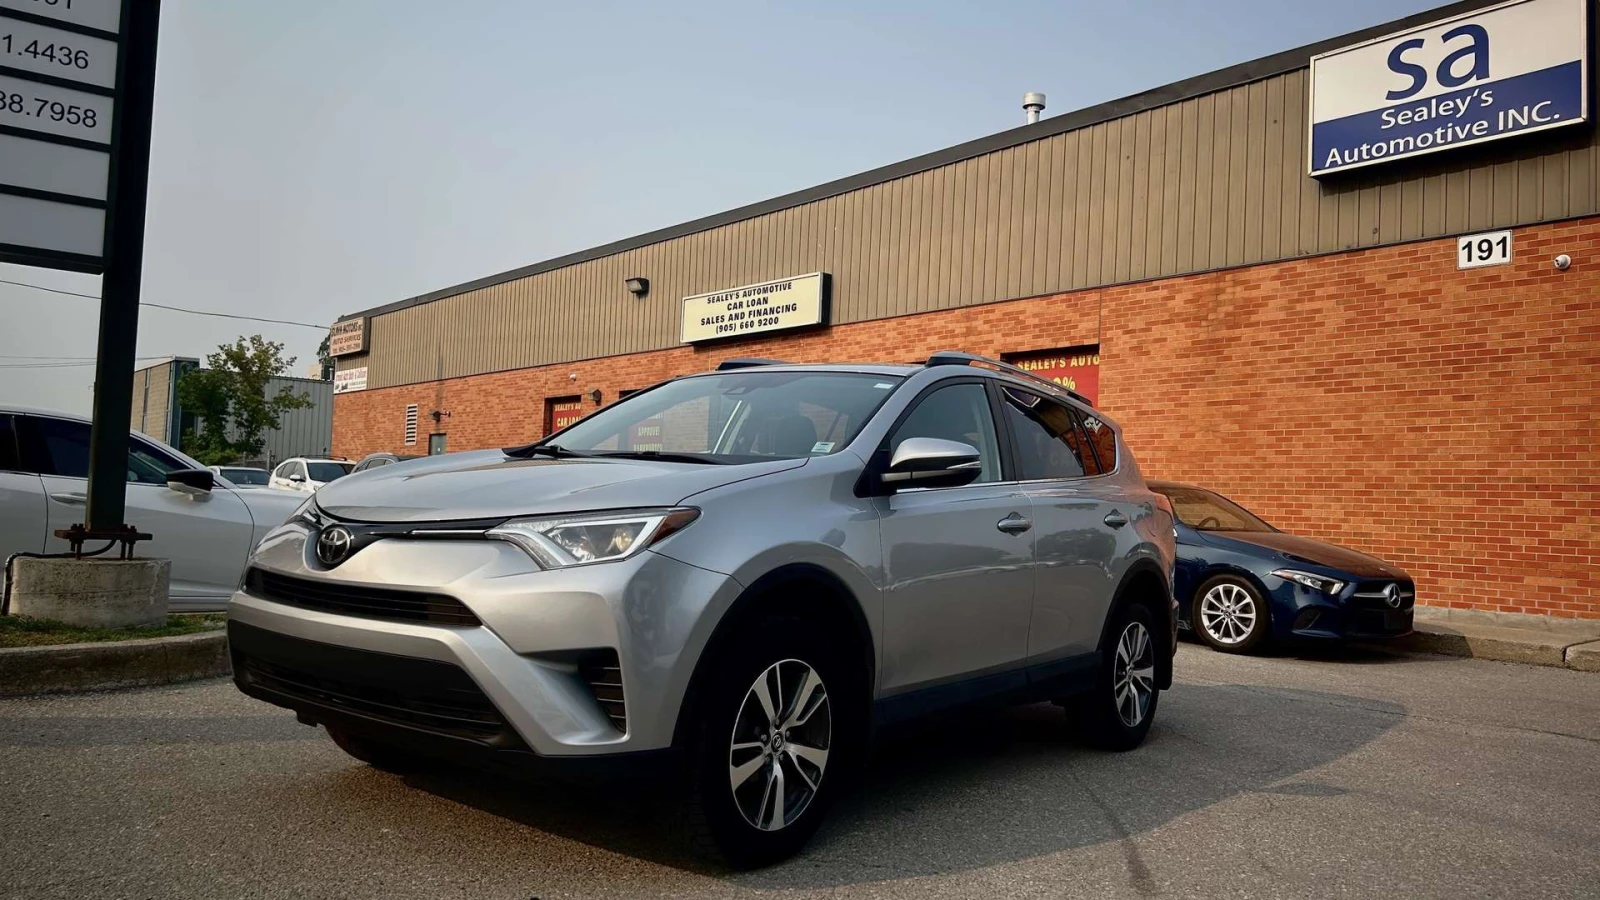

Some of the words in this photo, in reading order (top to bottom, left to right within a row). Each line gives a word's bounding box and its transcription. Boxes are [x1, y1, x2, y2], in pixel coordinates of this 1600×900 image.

[1385, 23, 1490, 101] sa
[1380, 88, 1494, 130] Sealey's
[1324, 119, 1489, 168] Automotive
[1497, 100, 1560, 131] INC.
[1461, 236, 1507, 262] 191
[707, 291, 740, 305] SEALEY'S
[742, 282, 792, 298] AUTOMOTIVE
[727, 301, 744, 311] CAR
[746, 296, 769, 307] LOAN
[700, 314, 725, 326] SALES
[728, 311, 746, 322] AND
[748, 303, 798, 319] FINANCING
[715, 323, 737, 334] (905)
[739, 319, 755, 330] 660
[758, 316, 779, 327] 9200
[1017, 357, 1066, 371] SEALEY'S
[1070, 354, 1100, 367] AUTO
